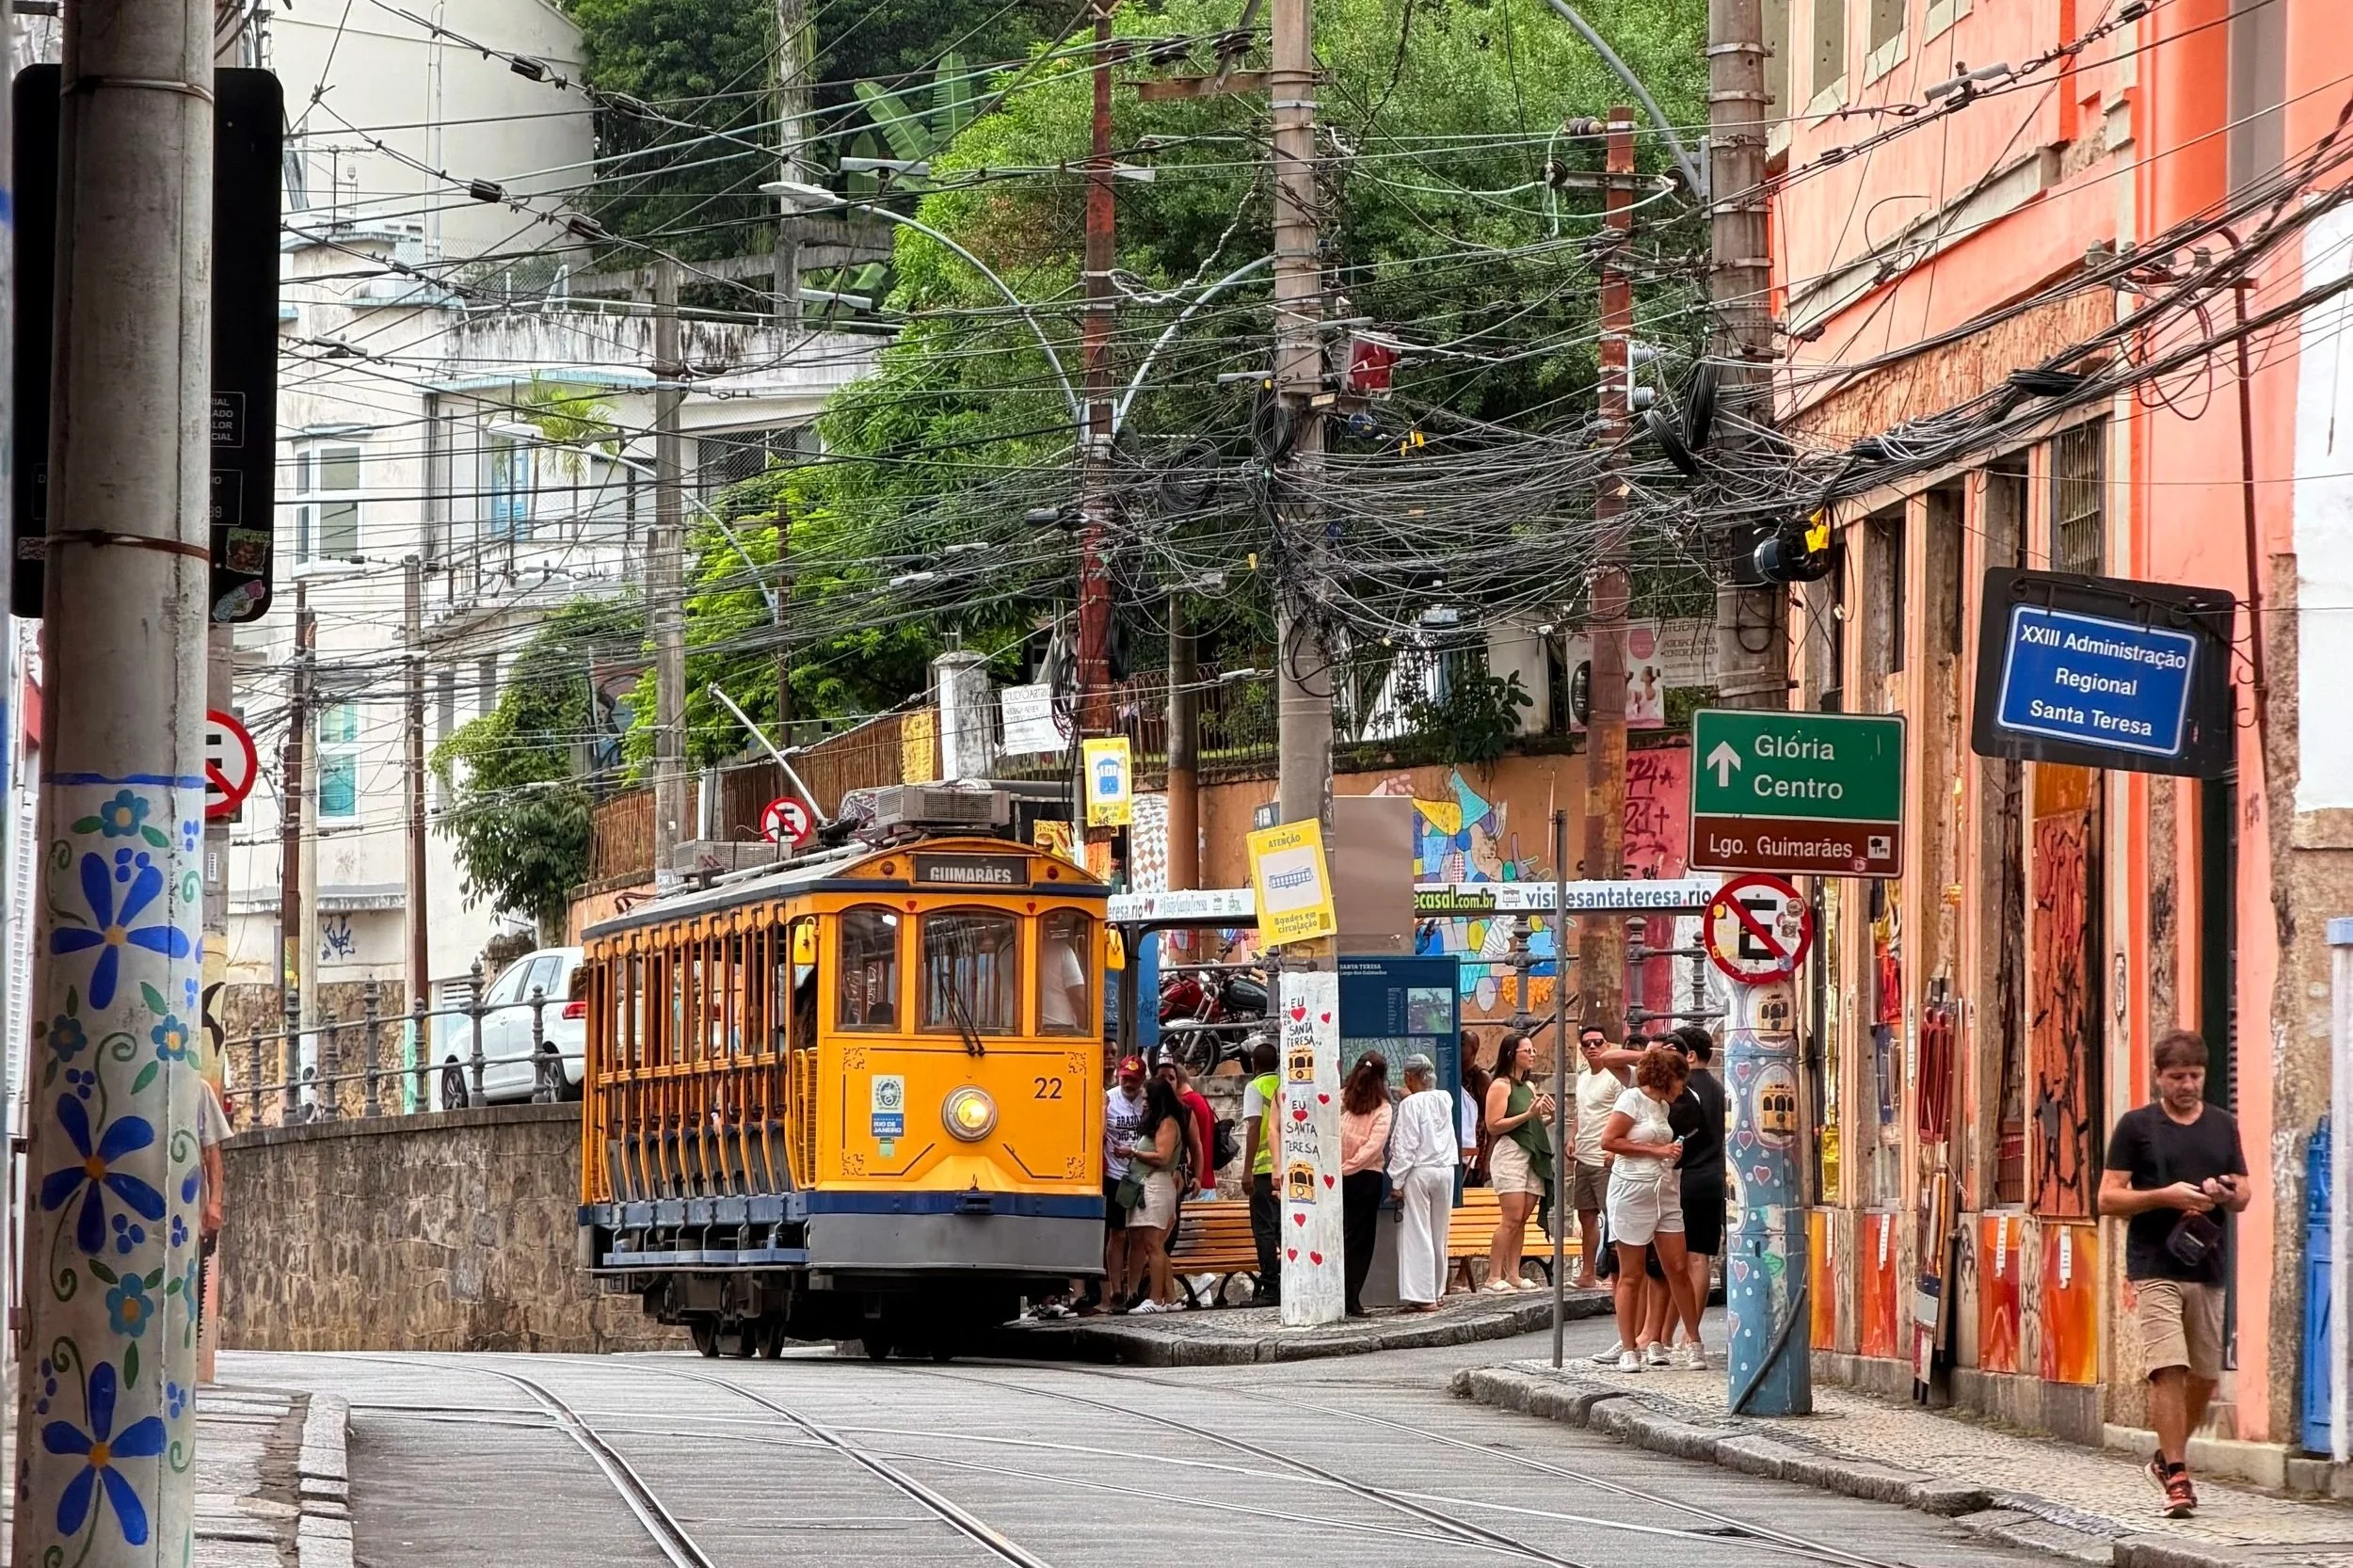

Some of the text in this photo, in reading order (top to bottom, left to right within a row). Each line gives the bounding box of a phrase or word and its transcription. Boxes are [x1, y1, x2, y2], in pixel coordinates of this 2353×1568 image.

[2021, 624, 2187, 670] XXIII Administração
[2055, 666, 2138, 696] Regional
[2029, 699, 2153, 737] Santa Teresa
[1754, 734, 1835, 760] Glória
[1753, 774, 1844, 800] Centro
[1268, 834, 1301, 848] ATENÇÃO
[1709, 833, 1853, 858] Lgo. Guimarães
[929, 865, 1012, 884] GUIMARÃES
[1526, 883, 1712, 909] visiesantateresa.rio
[1274, 913, 1304, 926] Bondes
[1277, 920, 1318, 934] circulação
[1290, 996, 1305, 1008] EU
[1289, 1022, 1314, 1036] SANTA
[1033, 1077, 1063, 1099] 22
[1291, 1100, 1306, 1111] EU
[1286, 1121, 1318, 1137] SANTA
[1285, 1140, 1321, 1160] TERESA
